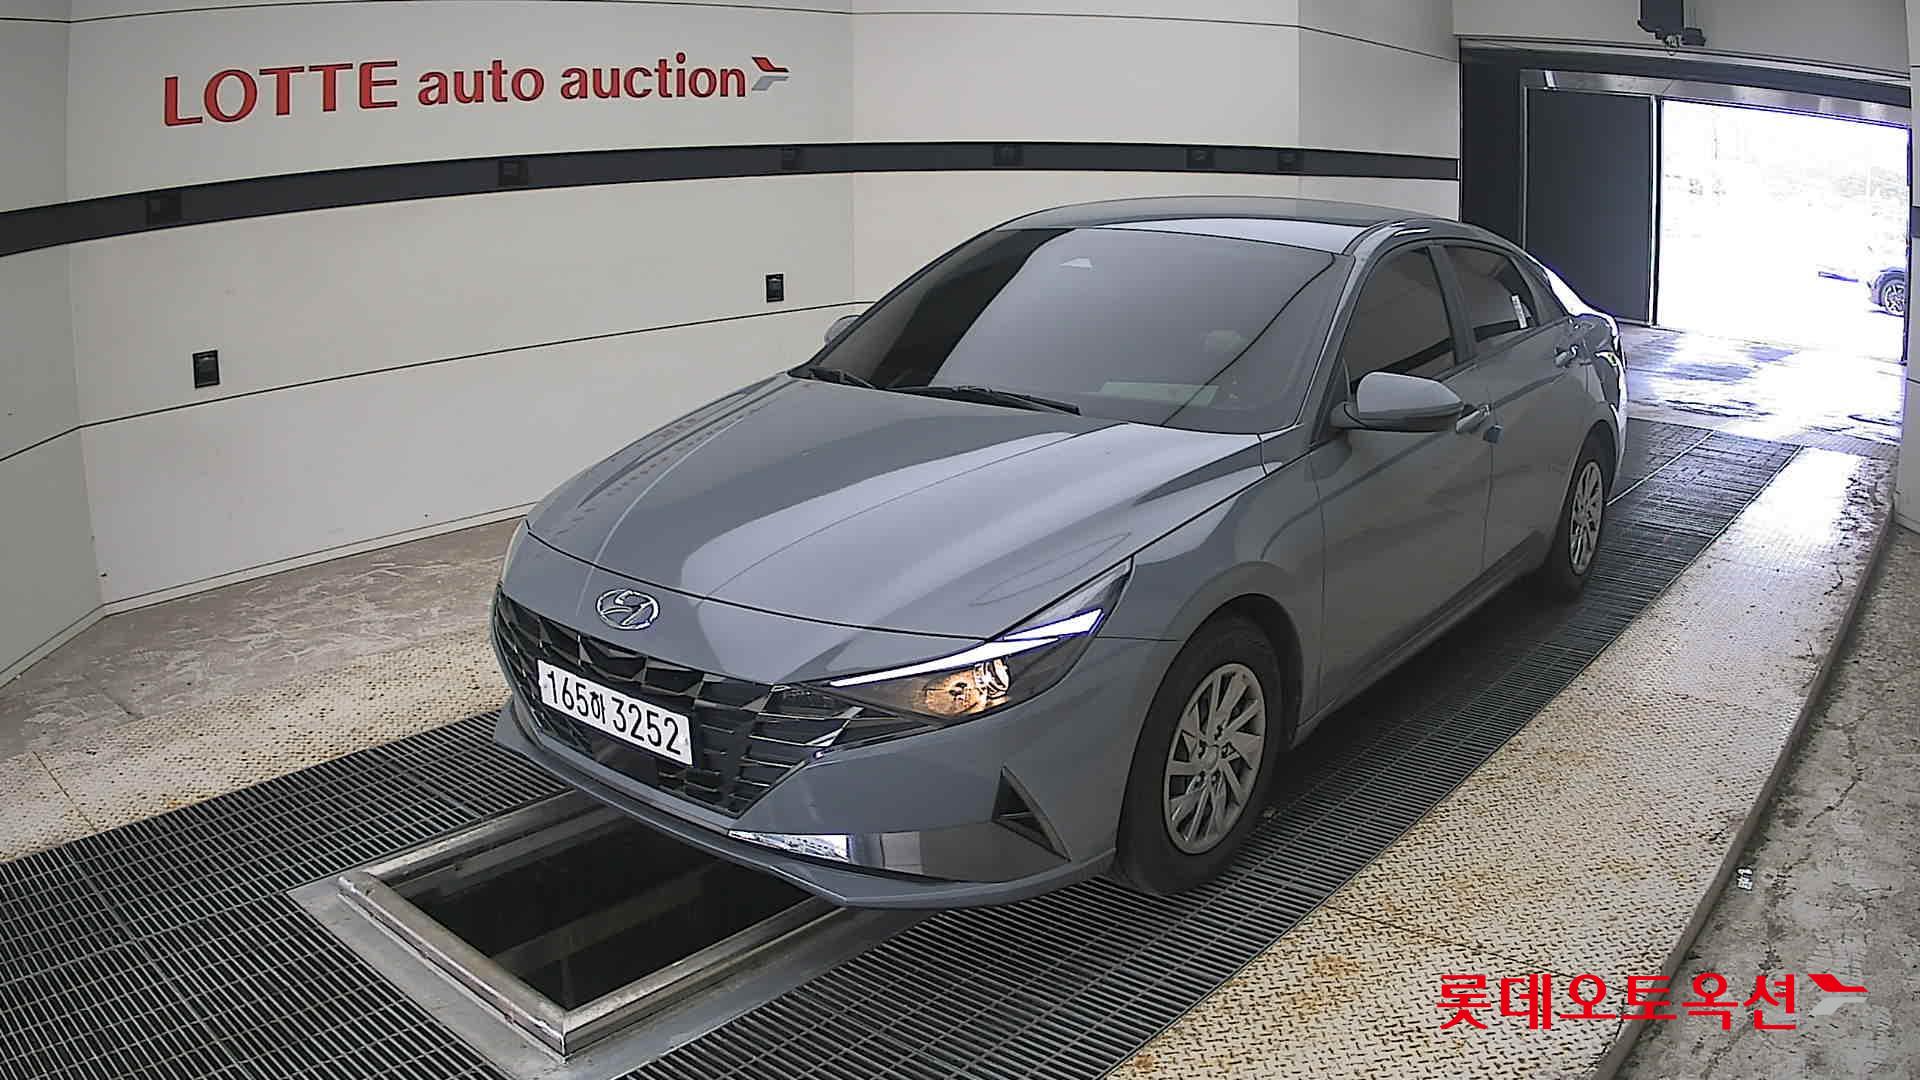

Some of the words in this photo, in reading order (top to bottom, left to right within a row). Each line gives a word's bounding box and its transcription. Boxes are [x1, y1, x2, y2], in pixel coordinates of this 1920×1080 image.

[164, 61, 398, 126] LOTTE
[417, 59, 545, 106] auto
[560, 52, 748, 99] auction
[547, 670, 606, 724] 165하
[611, 697, 681, 755] 3252
